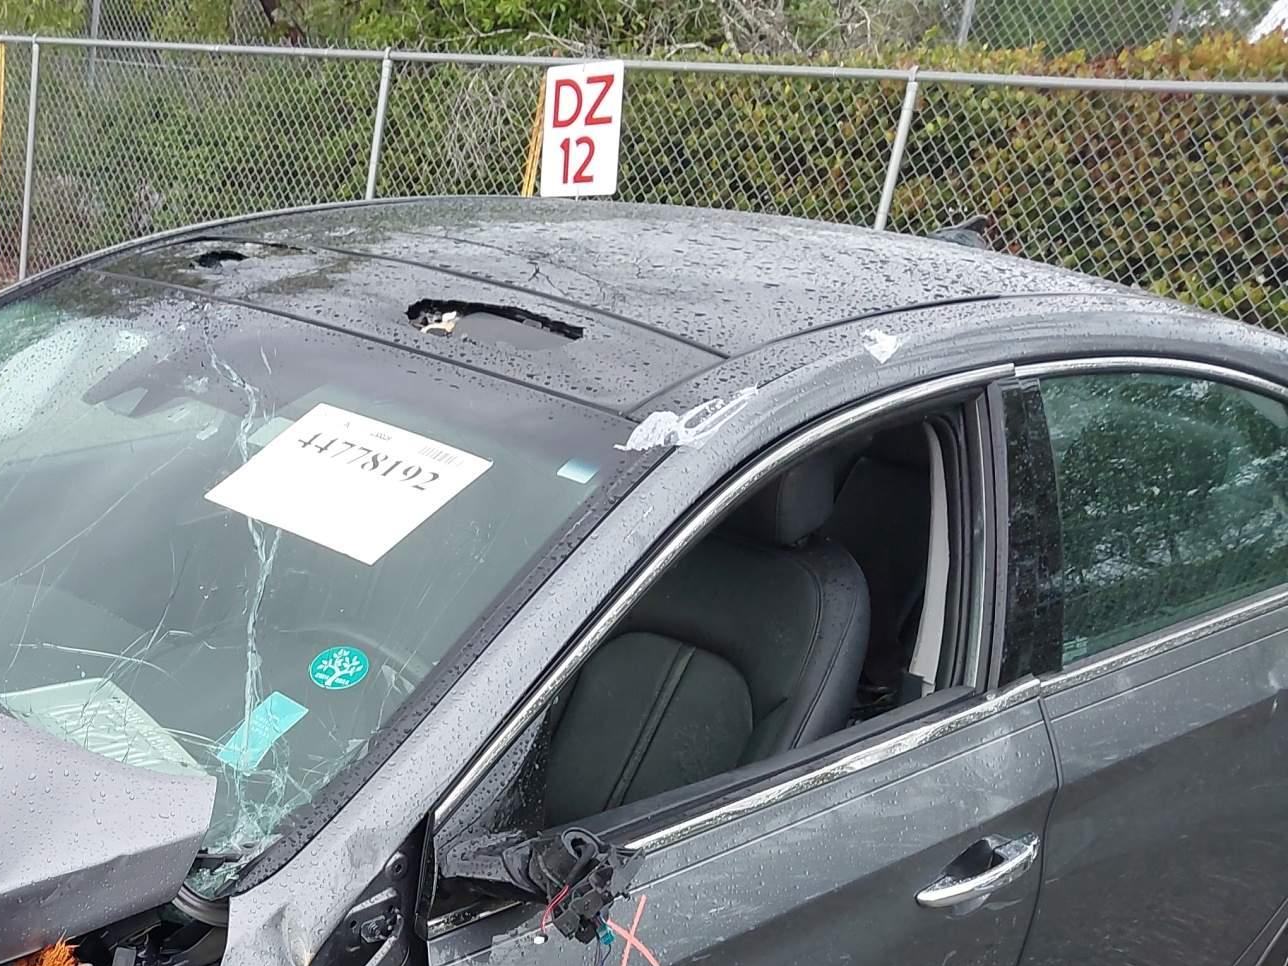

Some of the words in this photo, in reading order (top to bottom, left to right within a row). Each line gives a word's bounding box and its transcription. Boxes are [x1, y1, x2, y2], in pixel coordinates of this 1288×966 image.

[552, 74, 615, 129] DZ
[560, 135, 596, 184] 12
[297, 432, 441, 492] 44778192
